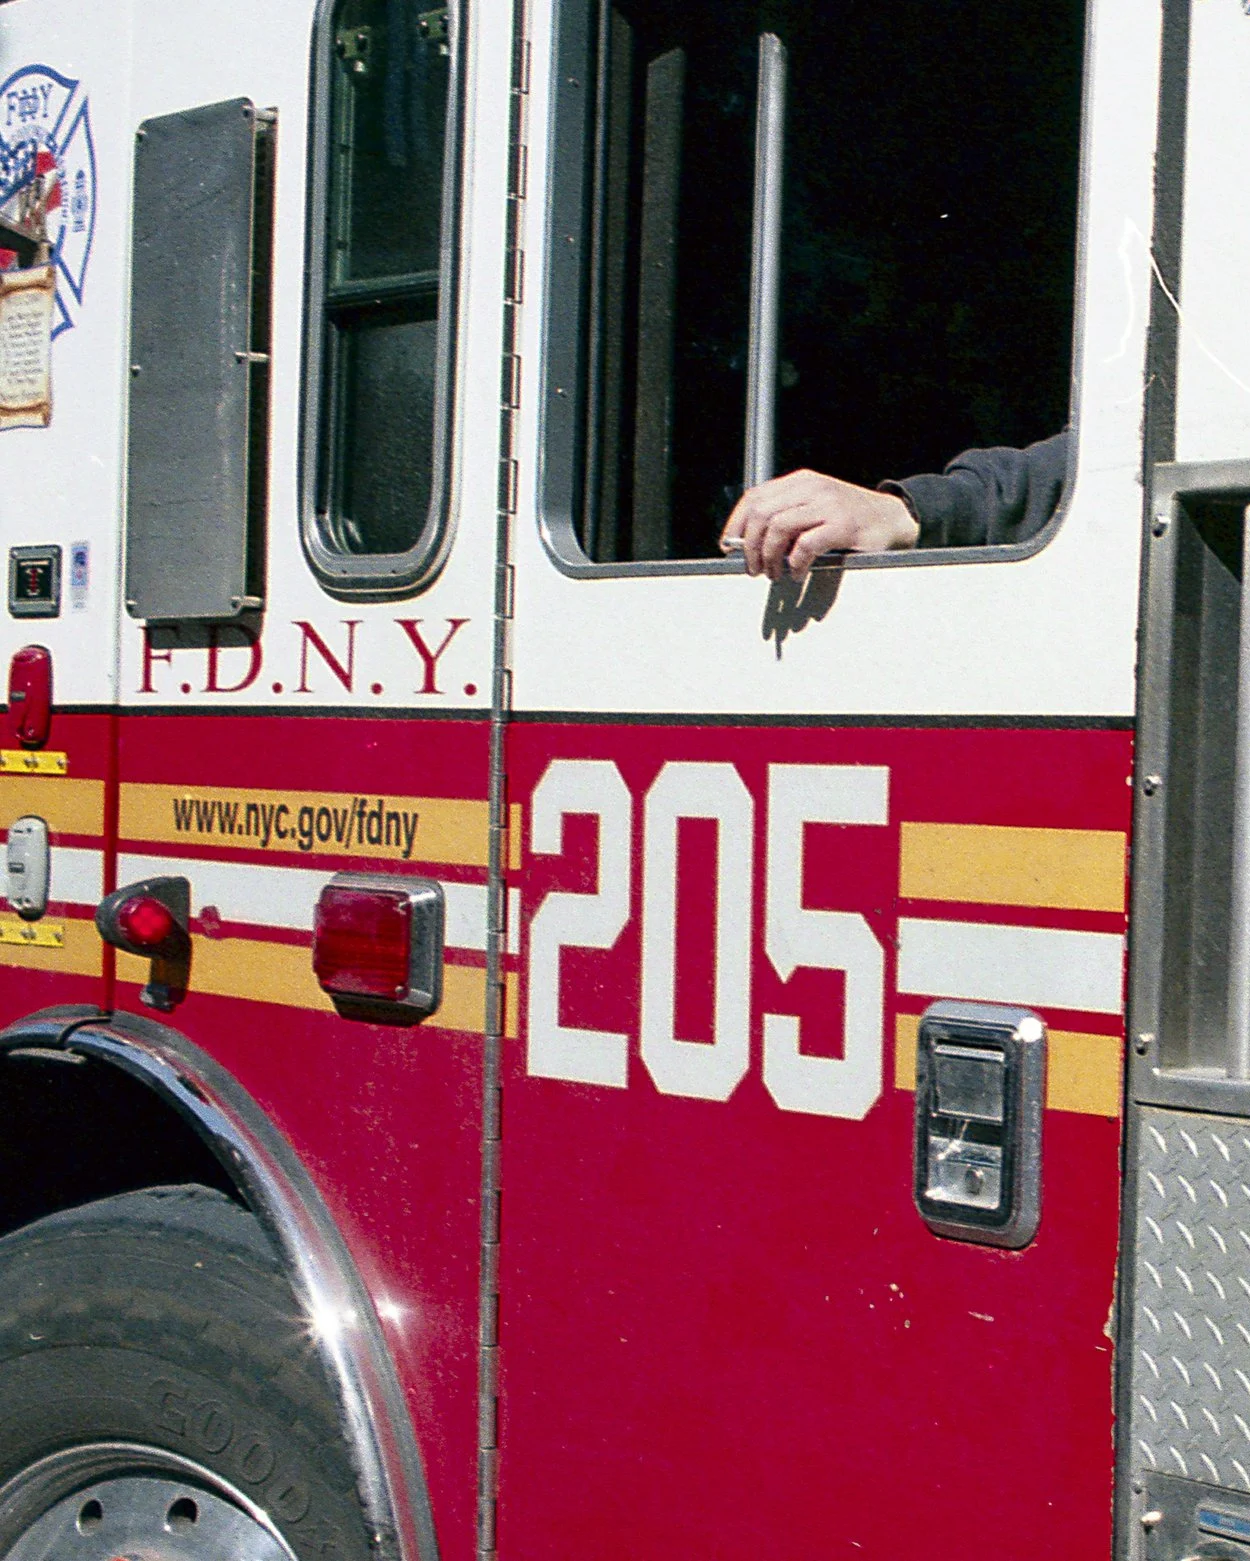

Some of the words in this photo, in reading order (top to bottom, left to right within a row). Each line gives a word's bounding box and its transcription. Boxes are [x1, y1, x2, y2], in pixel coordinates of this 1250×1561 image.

[137, 618, 477, 694] F.D.N.Y.
[173, 797, 418, 858] www.nyc.gov/fdny
[527, 759, 891, 1122] 205
